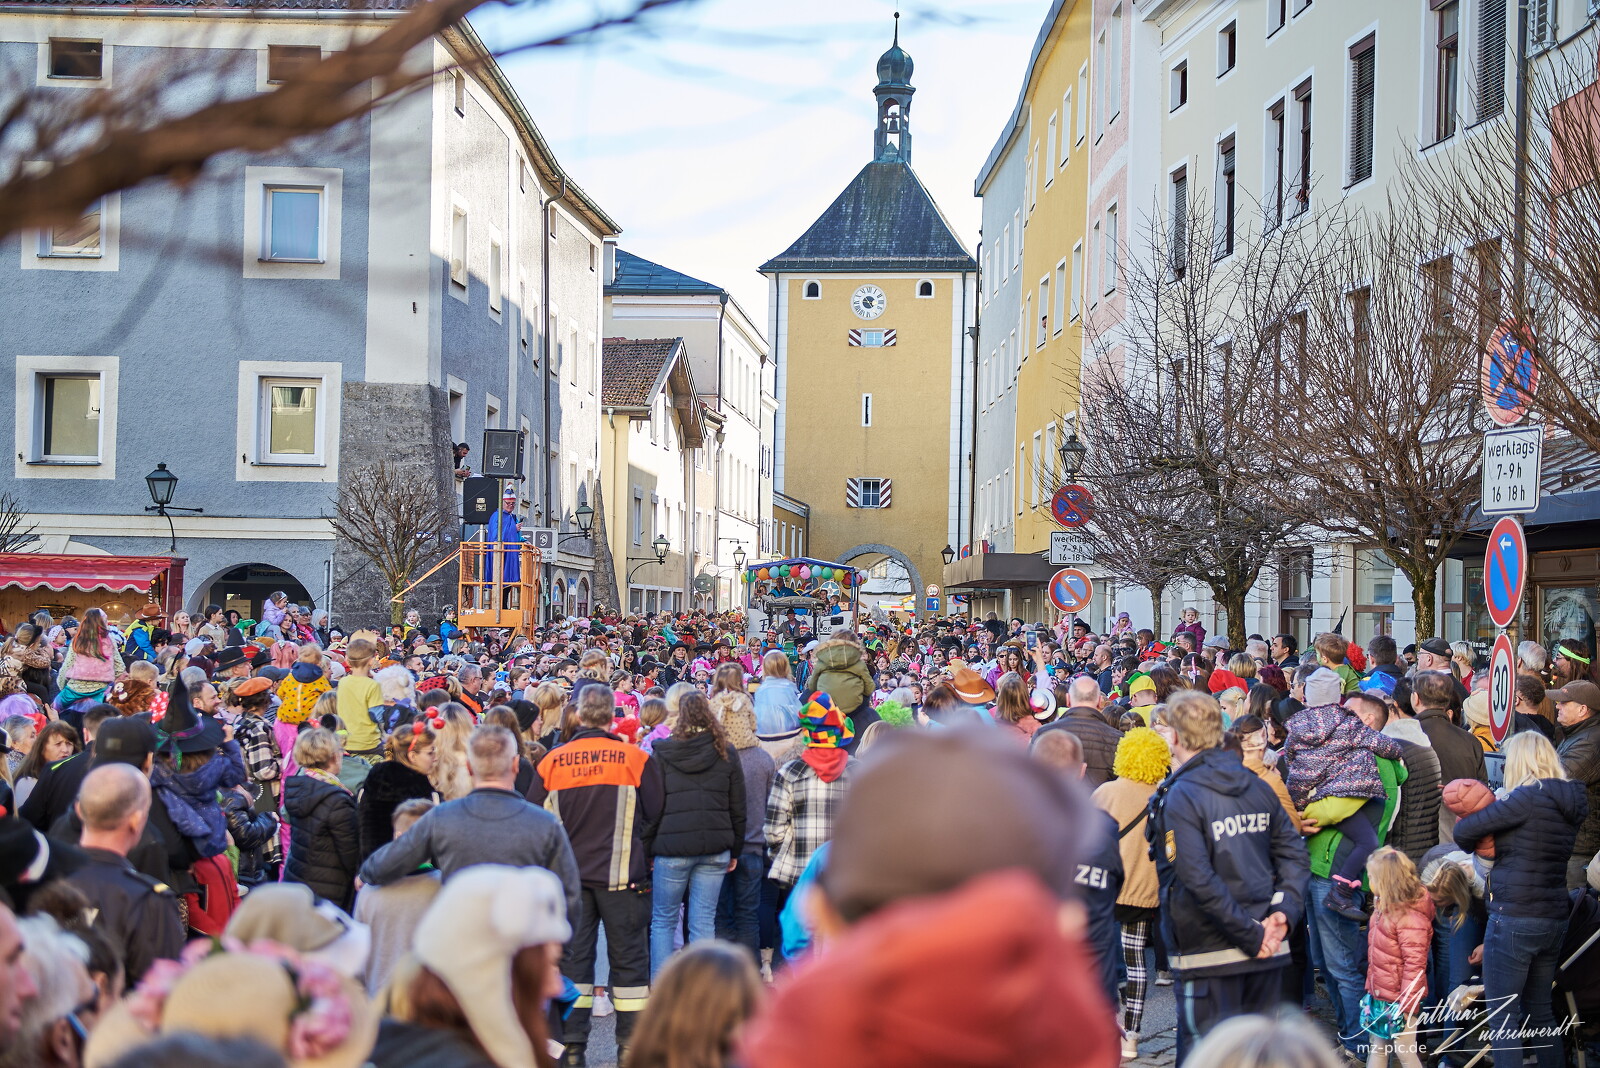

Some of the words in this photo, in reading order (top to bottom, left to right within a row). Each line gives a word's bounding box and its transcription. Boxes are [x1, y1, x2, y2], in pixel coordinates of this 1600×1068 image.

[1488, 440, 1535, 458] werktags
[1492, 486, 1501, 503] 16
[1508, 485, 1518, 502] 18
[1493, 664, 1508, 713] 30
[572, 765, 603, 778] LAUFEN
